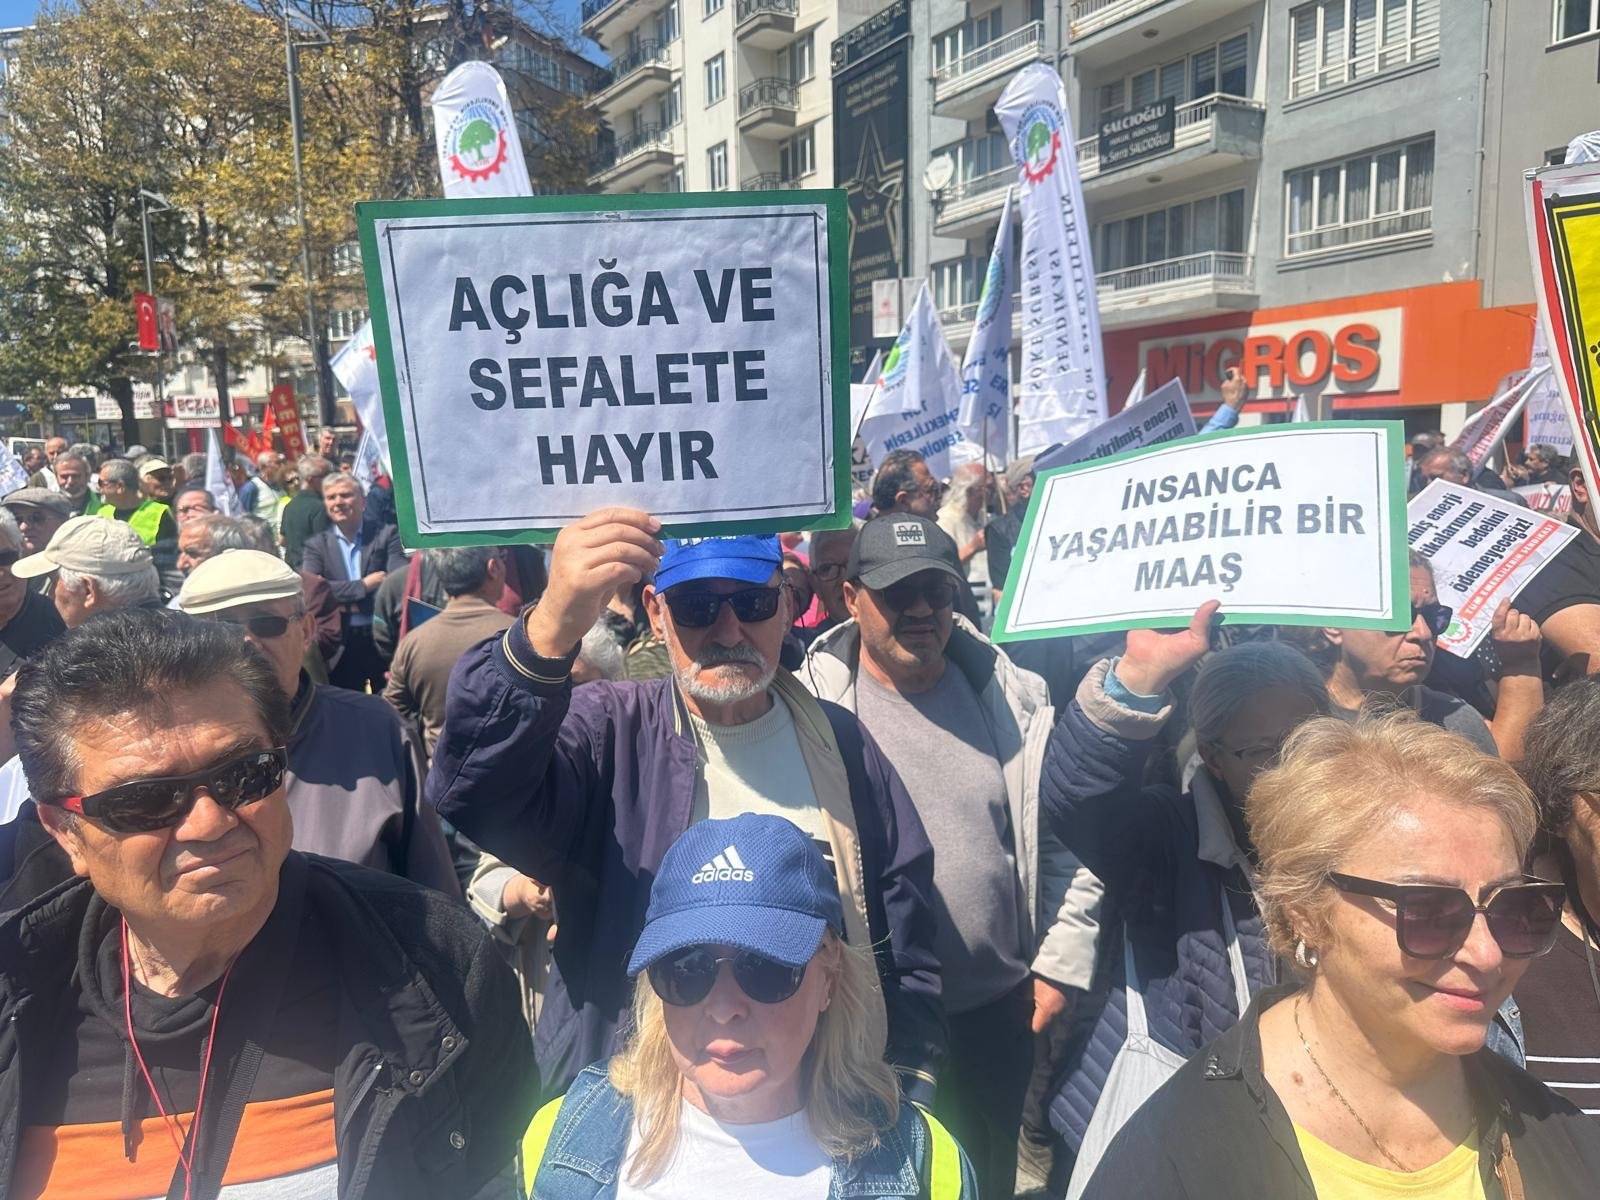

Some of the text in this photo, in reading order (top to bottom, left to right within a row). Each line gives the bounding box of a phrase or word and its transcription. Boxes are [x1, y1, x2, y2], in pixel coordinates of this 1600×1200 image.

[448, 258, 775, 345] AÇLIĞA VE
[469, 349, 768, 411] SEFALETE
[1143, 399, 1179, 432] enerji
[536, 430, 718, 486] HAYIR
[1121, 462, 1282, 511] İNSANCA
[1426, 492, 1463, 522] enerji
[1048, 495, 1366, 563] YAŞANABİLİR BİR
[1458, 508, 1510, 549] bedelini
[1134, 552, 1243, 593] MAAŞ
[1448, 517, 1535, 593] ödemeyeceğiz!
[1465, 596, 1485, 616] TÜM
[692, 867, 754, 884] adidas
